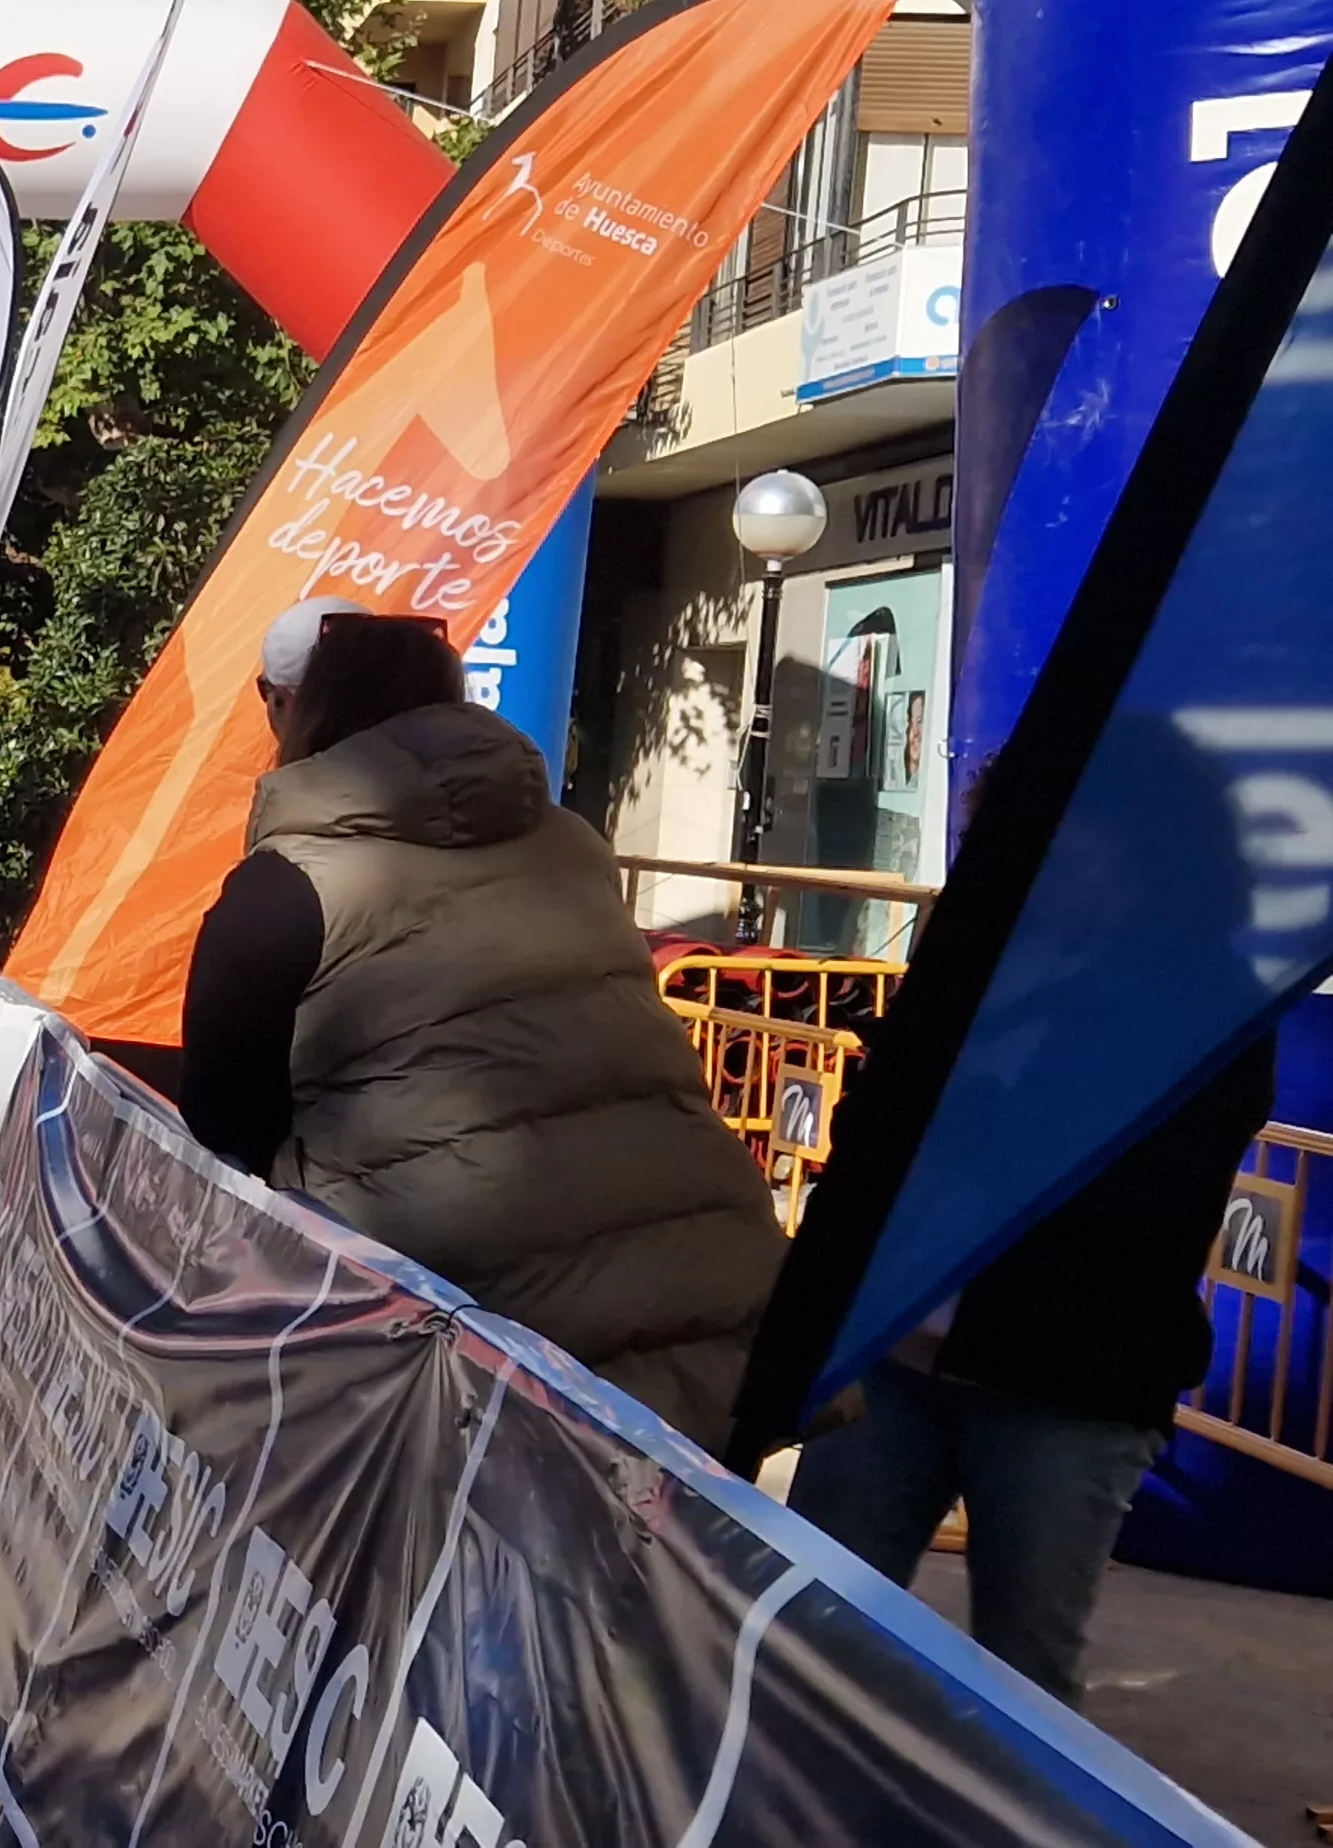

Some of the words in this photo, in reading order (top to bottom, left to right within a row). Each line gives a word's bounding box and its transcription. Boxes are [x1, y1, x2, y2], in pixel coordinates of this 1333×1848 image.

[531, 227, 597, 267] Deportes
[554, 197, 580, 220] de
[583, 206, 658, 256] Huesca
[572, 171, 709, 248] Ayuntamiento
[288, 432, 521, 563] Hacemos
[268, 498, 476, 610] deporte
[126, 1425, 226, 1616] ESIC
